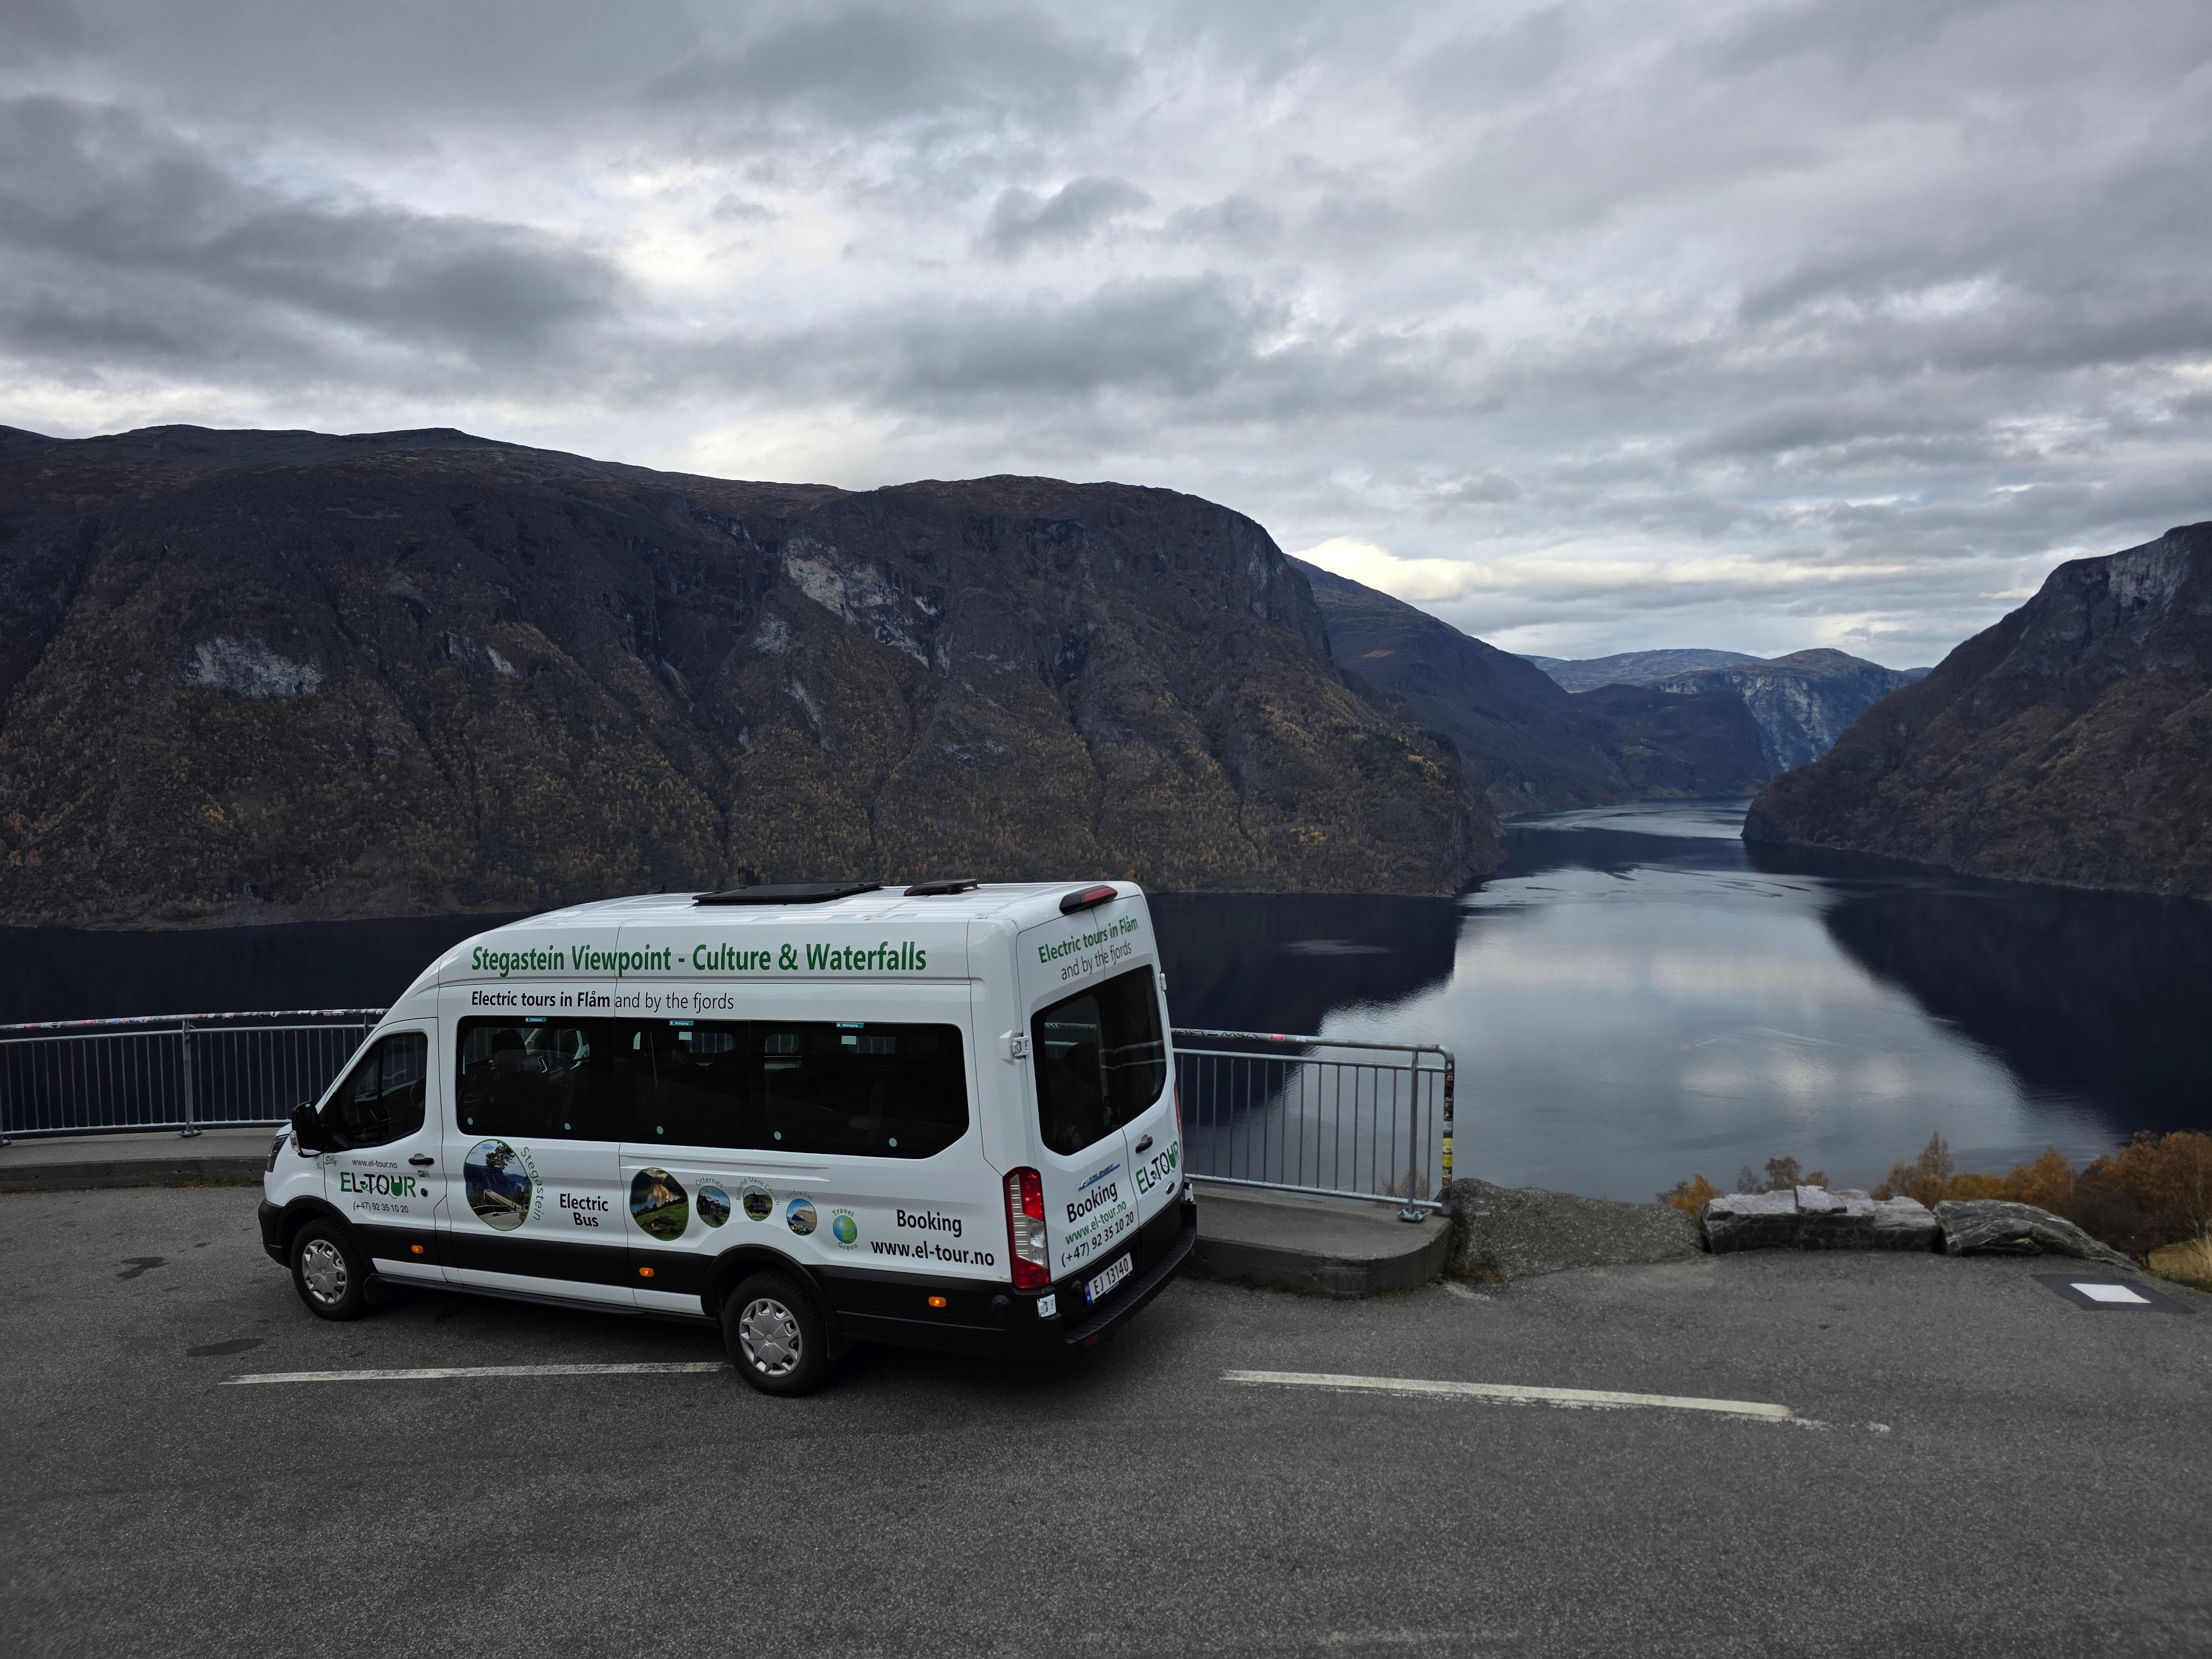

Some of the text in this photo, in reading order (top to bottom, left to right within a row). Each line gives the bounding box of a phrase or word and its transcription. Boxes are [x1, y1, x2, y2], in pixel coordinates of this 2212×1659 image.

[1038, 915, 1139, 963] Electric tours in Flåm
[472, 945, 564, 977] Stegastein
[572, 943, 671, 977] Viewpoint
[693, 943, 771, 971] Culture
[779, 943, 798, 971] &
[806, 941, 926, 971] Waterfalls
[1061, 940, 1132, 980] and by the fjords
[472, 990, 734, 1014] Electric tours in Flåm and by the fjords
[325, 1156, 337, 1167] Elly
[352, 1159, 398, 1168] www.el-tour.no
[340, 1172, 416, 1199] EL-TOUR
[521, 1146, 544, 1220] Stegastein
[696, 1177, 724, 1188] Otternes
[748, 1176, 764, 1186] Stave
[353, 1201, 371, 1211] (+47)
[400, 1205, 409, 1213] 20
[560, 1193, 608, 1211] Electric
[785, 1190, 813, 1200] Undredal
[1066, 1182, 1118, 1223] Booking
[573, 1212, 598, 1227] Bus
[832, 1208, 854, 1217] Travel
[896, 1209, 962, 1238] Booking
[1065, 1201, 1126, 1244] www.el-tour.no
[838, 1241, 858, 1250] Green
[1061, 1211, 1134, 1267] (+47) 92 35 10 20
[870, 1240, 994, 1266] www.el-tour.no
[1093, 1276, 1104, 1295] EJ
[1106, 1258, 1129, 1285] 13140
